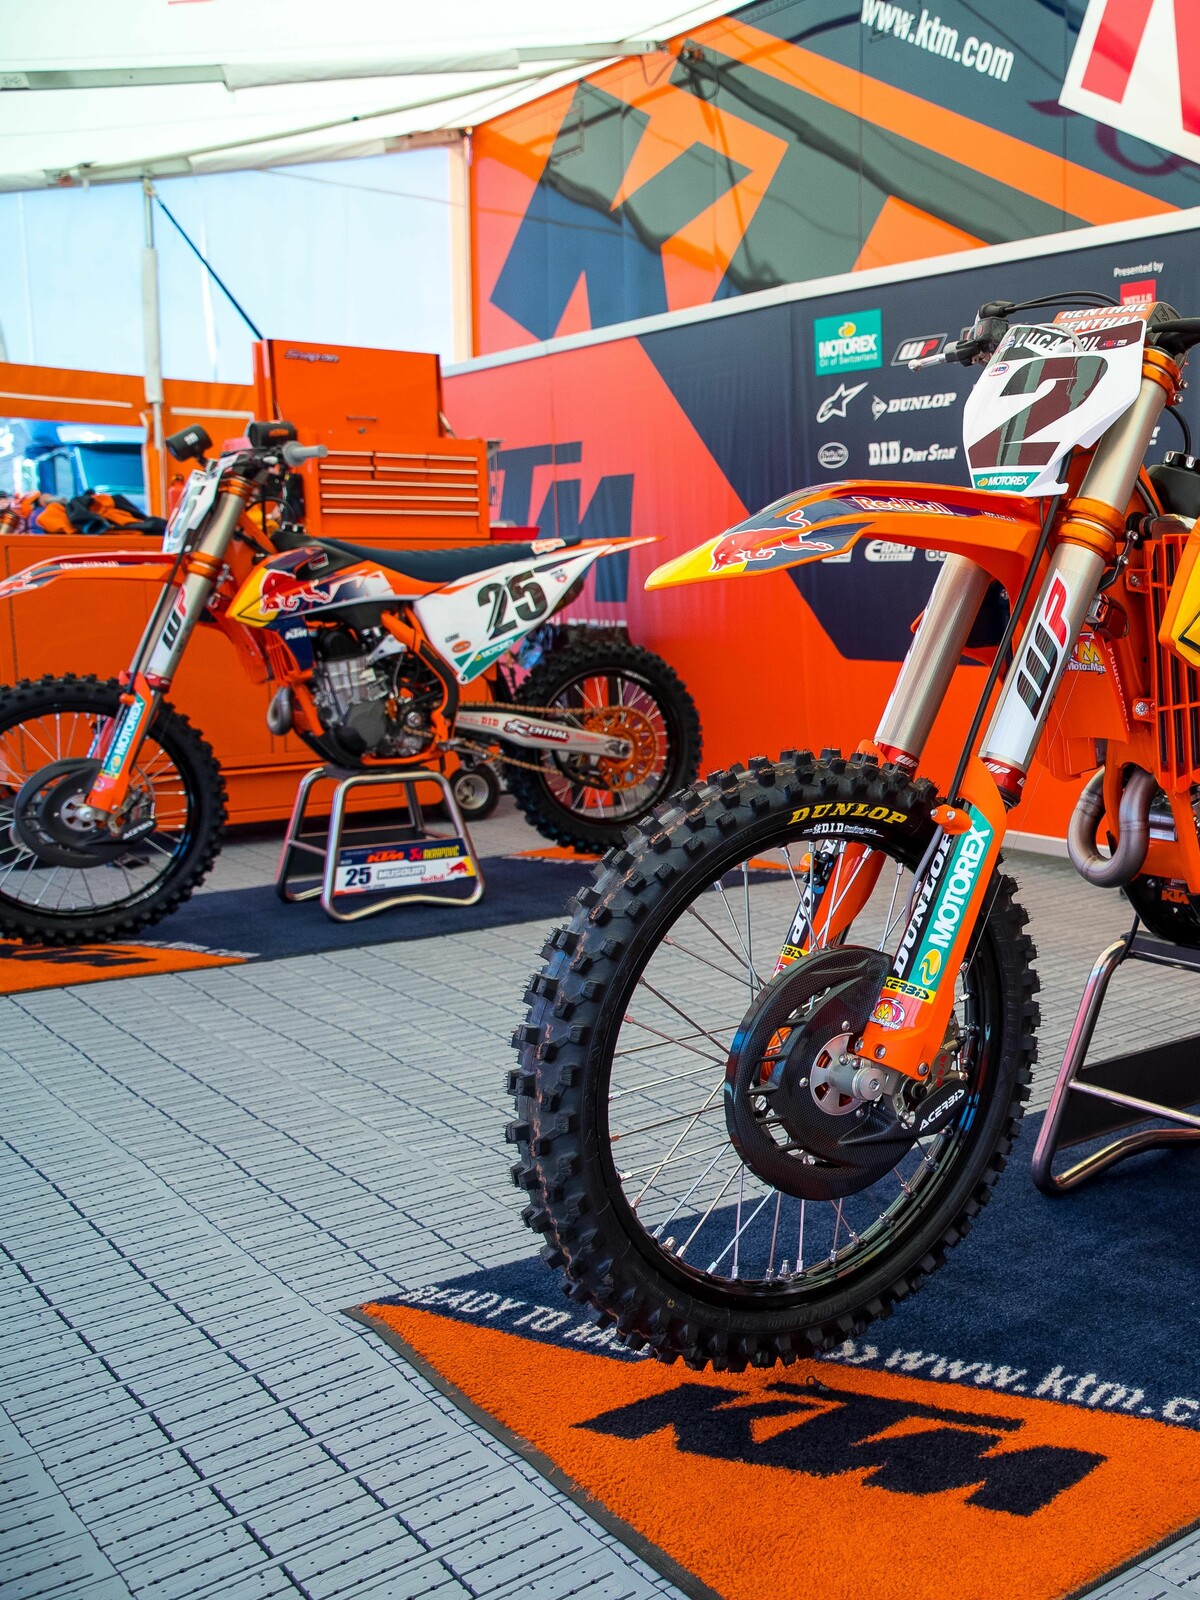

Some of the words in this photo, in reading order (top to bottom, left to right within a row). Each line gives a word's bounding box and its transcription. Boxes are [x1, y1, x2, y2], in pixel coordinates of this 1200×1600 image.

[860, 0, 1015, 83] www.ktm.com
[1113, 262, 1153, 278] Presented
[1153, 261, 1164, 273] by
[1122, 293, 1153, 306] WELLS
[818, 334, 878, 358] MOTOREX
[1014, 332, 1073, 352] LUCA
[887, 392, 957, 413] DUNLOP
[968, 355, 1109, 469] 2
[868, 440, 901, 466] DID
[987, 475, 1029, 487] MOTOREX
[851, 496, 908, 511] Red
[899, 499, 955, 516] Bull
[477, 569, 548, 640] 25
[119, 699, 144, 756] MOTOREX
[787, 803, 908, 825] DUNLOP
[366, 849, 405, 863] KTM
[345, 866, 372, 887] 25
[928, 828, 991, 949] MOTOREX
[883, 978, 930, 1001] CERBIS
[399, 1286, 525, 1319] READY
[513, 1305, 572, 1331] TO
[562, 1320, 650, 1357] RA
[570, 1382, 1107, 1517] KTM
